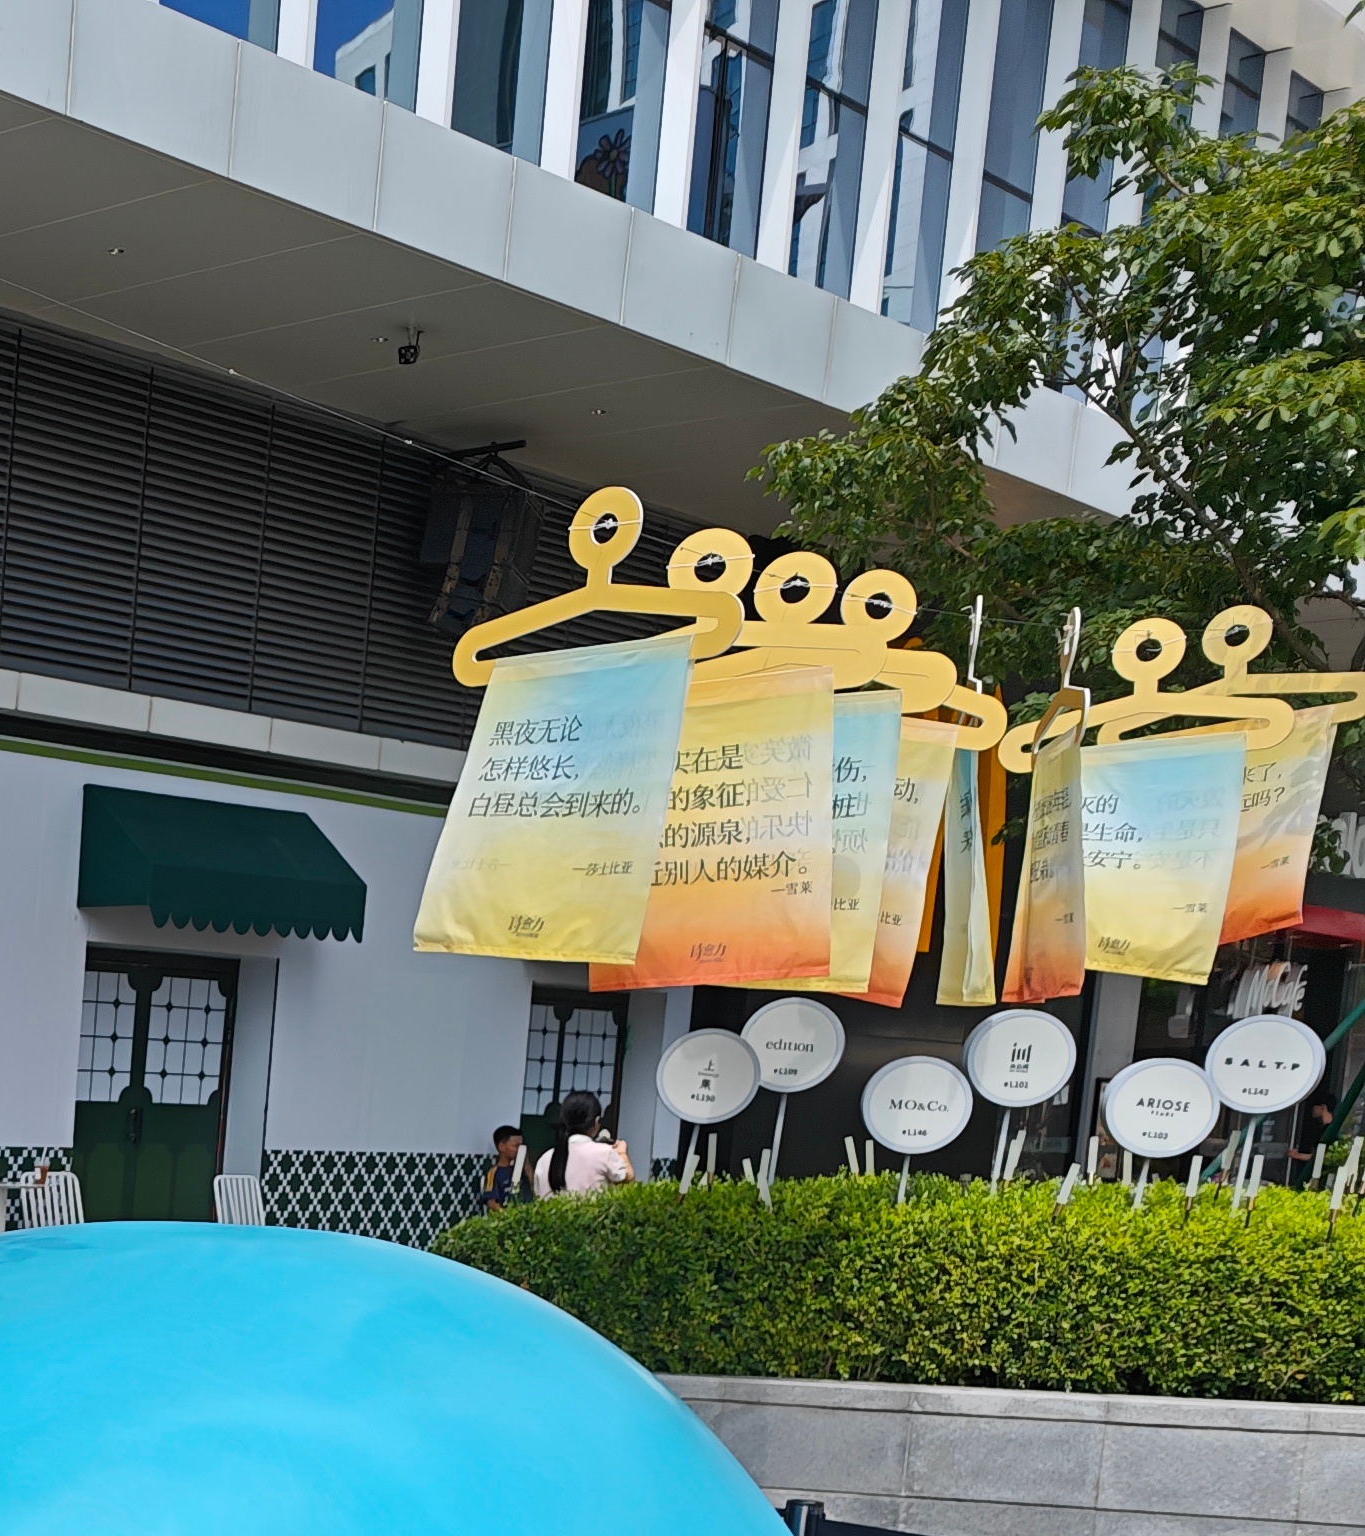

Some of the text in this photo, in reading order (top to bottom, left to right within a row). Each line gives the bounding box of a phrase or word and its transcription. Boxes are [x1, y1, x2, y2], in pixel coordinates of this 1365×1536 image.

[489, 714, 583, 747] 黑夜无论
[468, 787, 641, 818] 白昼总会到来的。
[766, 1039, 814, 1053] edition
[1135, 1097, 1191, 1113] ARIOSE
